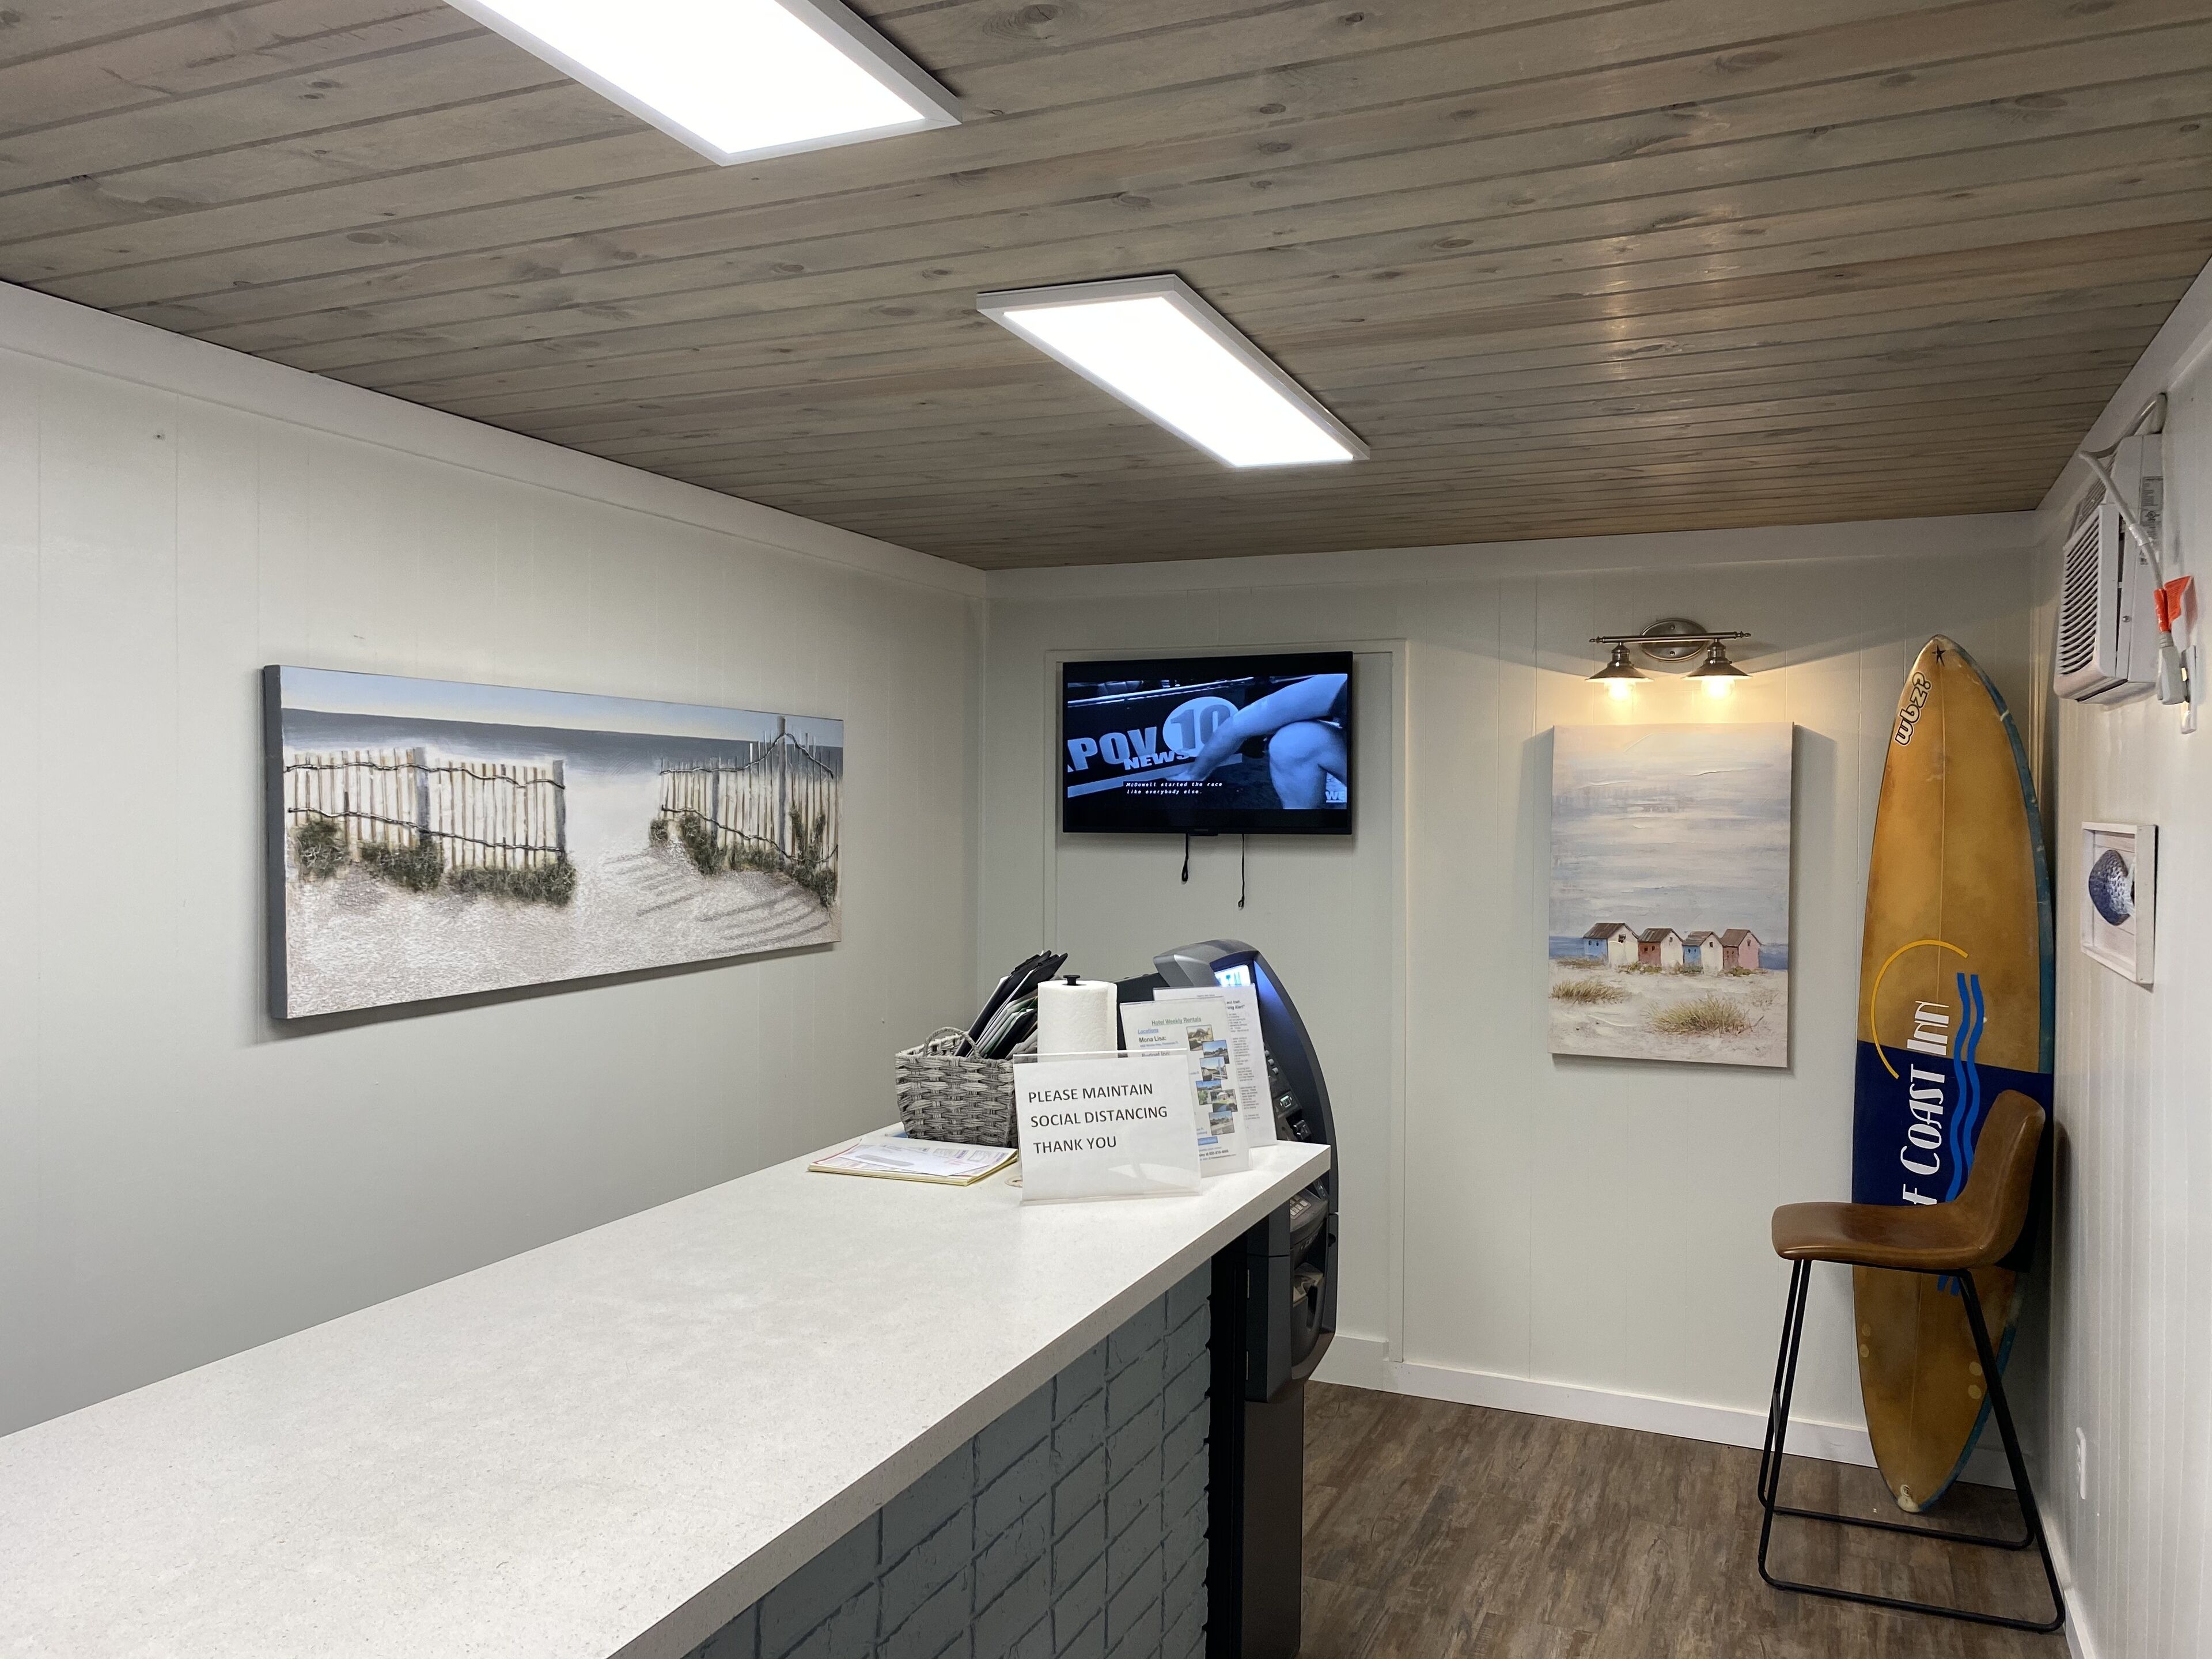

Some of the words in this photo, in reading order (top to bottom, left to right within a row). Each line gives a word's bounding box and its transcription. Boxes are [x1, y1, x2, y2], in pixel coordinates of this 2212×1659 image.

[1170, 704, 1231, 749] 10
[1067, 726, 1157, 772] POV
[1123, 750, 1190, 771] NEWS
[1029, 1089, 1078, 1103] PLEASE
[1082, 1083, 1153, 1099] MAINTAIN
[1031, 1113, 1081, 1127] SOCIAL
[1085, 1106, 1168, 1123] DISTANCING
[1900, 1063, 1945, 1175] COAST
[1033, 1139, 1083, 1154] THANK
[1086, 1136, 1117, 1149] YOU
